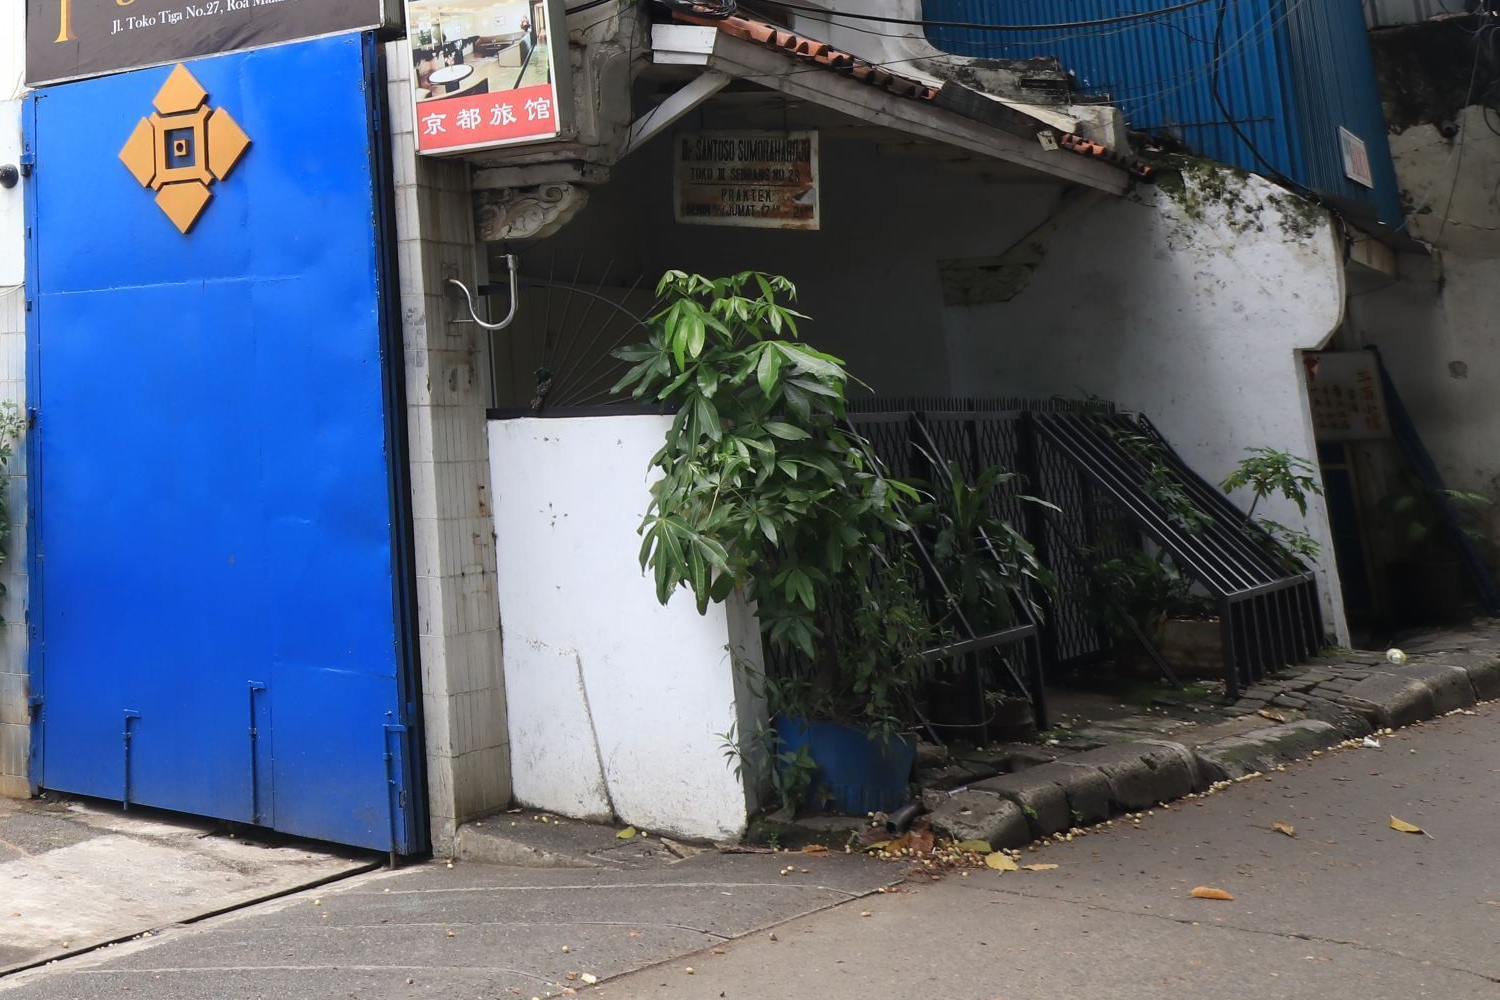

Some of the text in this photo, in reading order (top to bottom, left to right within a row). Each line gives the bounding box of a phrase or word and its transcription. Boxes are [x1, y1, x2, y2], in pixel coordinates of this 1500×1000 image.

[110, 19, 124, 36] Jl.
[126, 14, 156, 30] Toko
[158, 8, 183, 26] Tiga
[185, 0, 224, 20] No.27,
[695, 138, 735, 162] SANTOSO
[690, 167, 713, 181] TOKO
[721, 187, 772, 203] PRAKTEK
[727, 204, 755, 217] JUMAT
